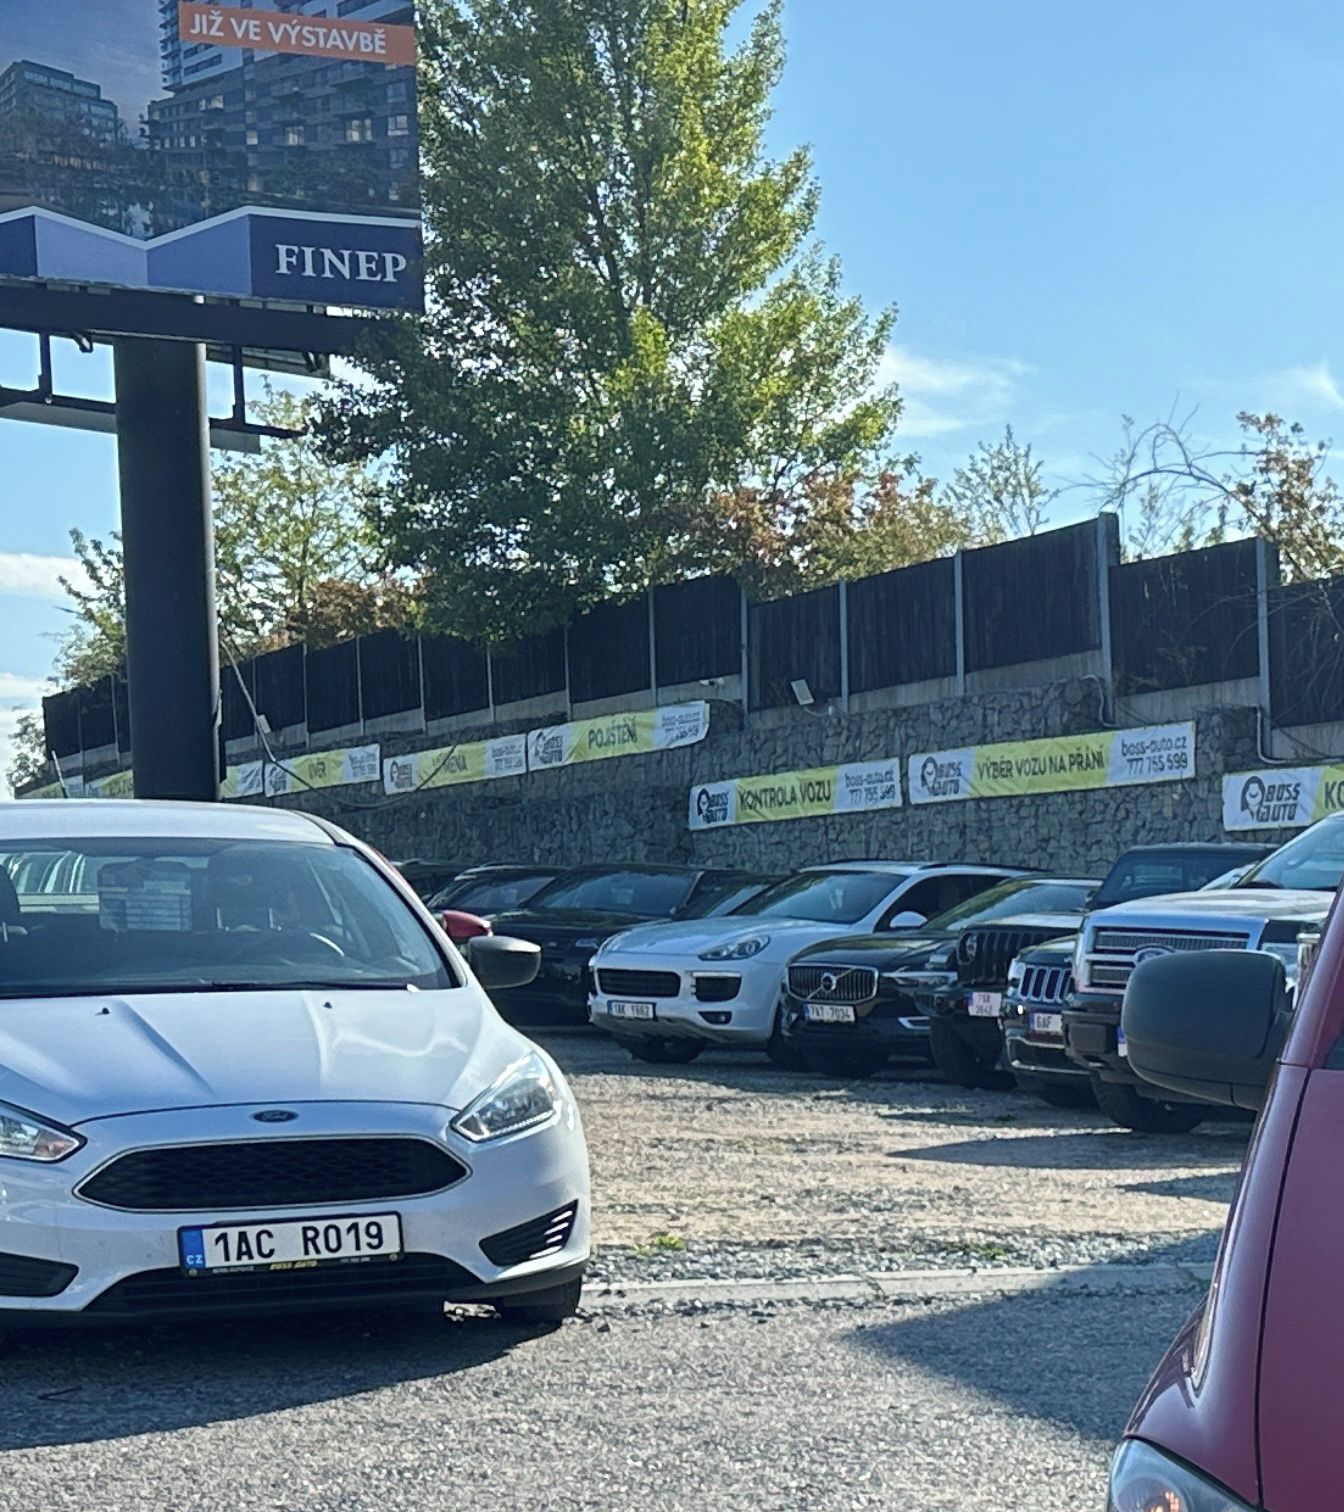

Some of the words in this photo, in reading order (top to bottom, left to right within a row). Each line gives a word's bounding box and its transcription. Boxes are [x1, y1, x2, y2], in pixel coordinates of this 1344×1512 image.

[190, 10, 224, 36] JIŽ
[230, 17, 262, 41] VE
[267, 19, 386, 54] VÝSTAVBĚ
[275, 244, 407, 284] FINEP
[1121, 736, 1187, 757] boss-auto.cz
[977, 756, 1013, 779] VÝBĚR
[1015, 756, 1046, 776] VOZU
[1050, 754, 1066, 774] NA
[1069, 744, 1104, 773] PŘÁNÍ
[1126, 757, 1144, 775] 777
[1146, 755, 1165, 773] 755
[1167, 753, 1187, 770] 599
[738, 783, 799, 811] KONTROLA
[800, 780, 831, 801] VOZU
[1266, 782, 1301, 803] BOSS
[1259, 802, 1297, 822] AUTO
[215, 1229, 275, 1262] 1AC
[186, 1254, 202, 1265] CZ
